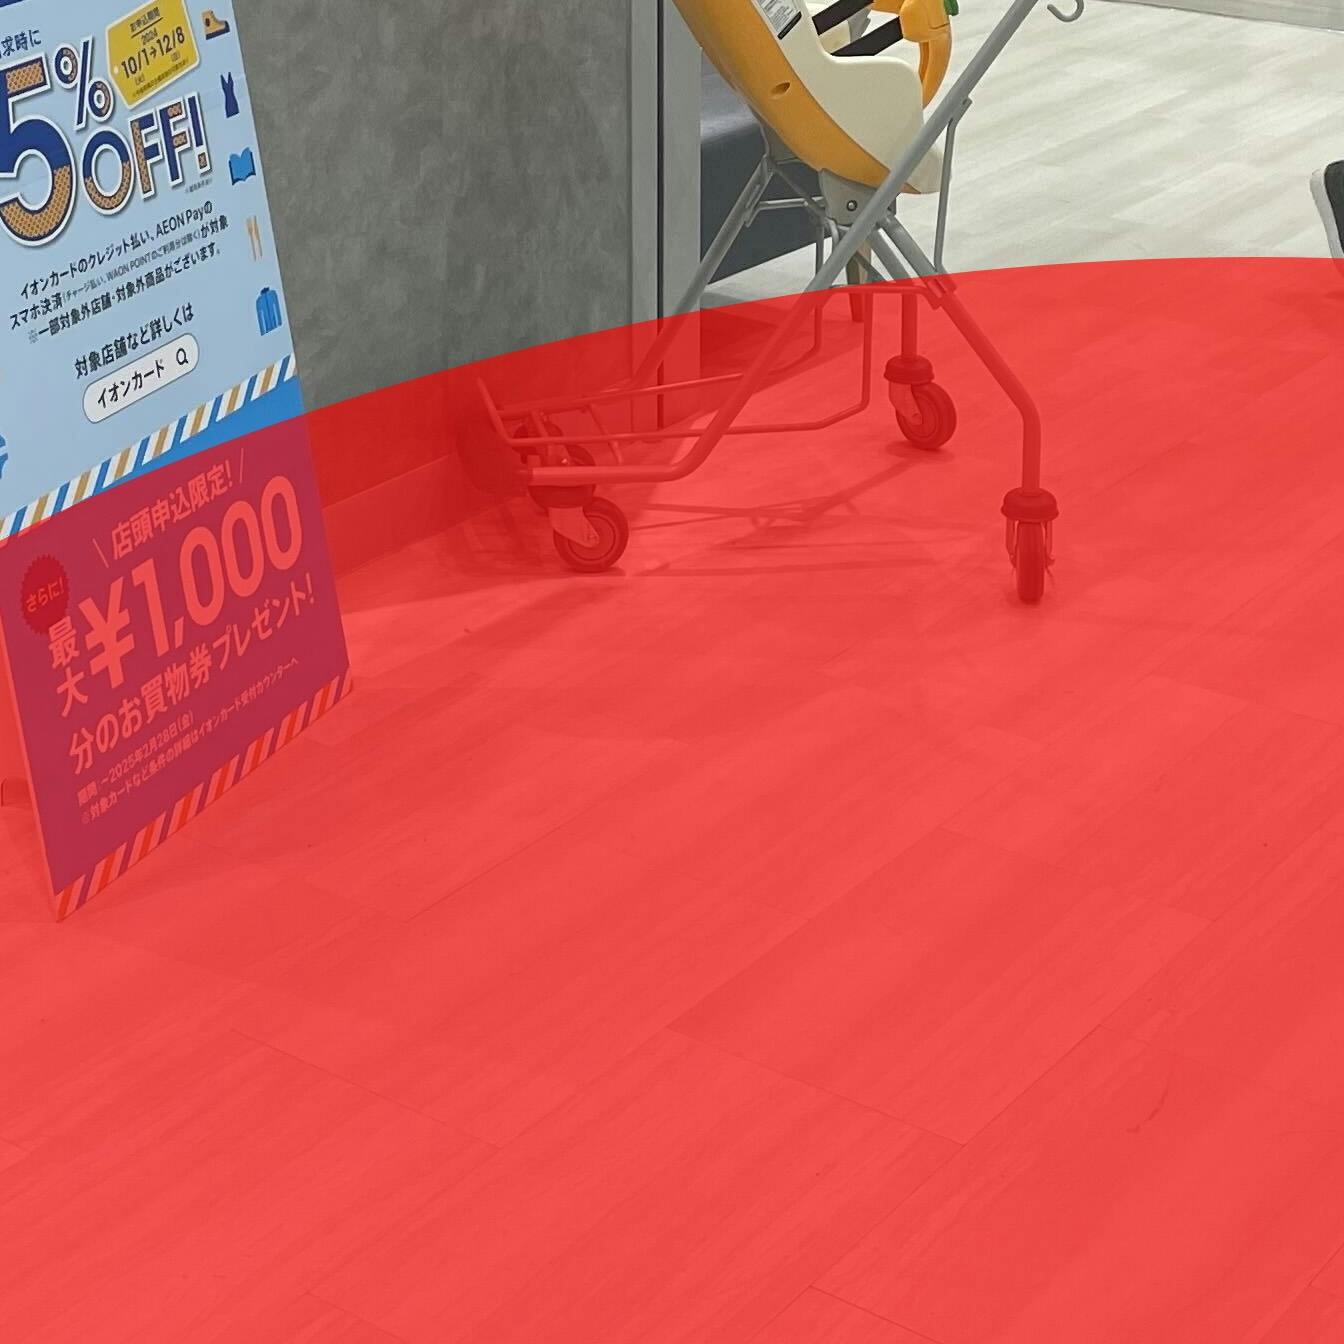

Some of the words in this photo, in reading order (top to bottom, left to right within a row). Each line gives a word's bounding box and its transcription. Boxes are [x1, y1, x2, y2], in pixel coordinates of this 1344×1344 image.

[81, 91, 212, 215] OFF!
[27, 241, 221, 344] ※一部対象外店舗・対象外商品がございます。
[74, 302, 194, 379] 対象店舗など詳しくは
[97, 359, 164, 409] イオンカード
[112, 461, 233, 560] 店頭申込限定!
[25, 577, 65, 614] さらに!
[78, 475, 302, 690] ¥1,000
[48, 616, 89, 717] 最大
[70, 573, 314, 775] 分のお買物券プレゼント!
